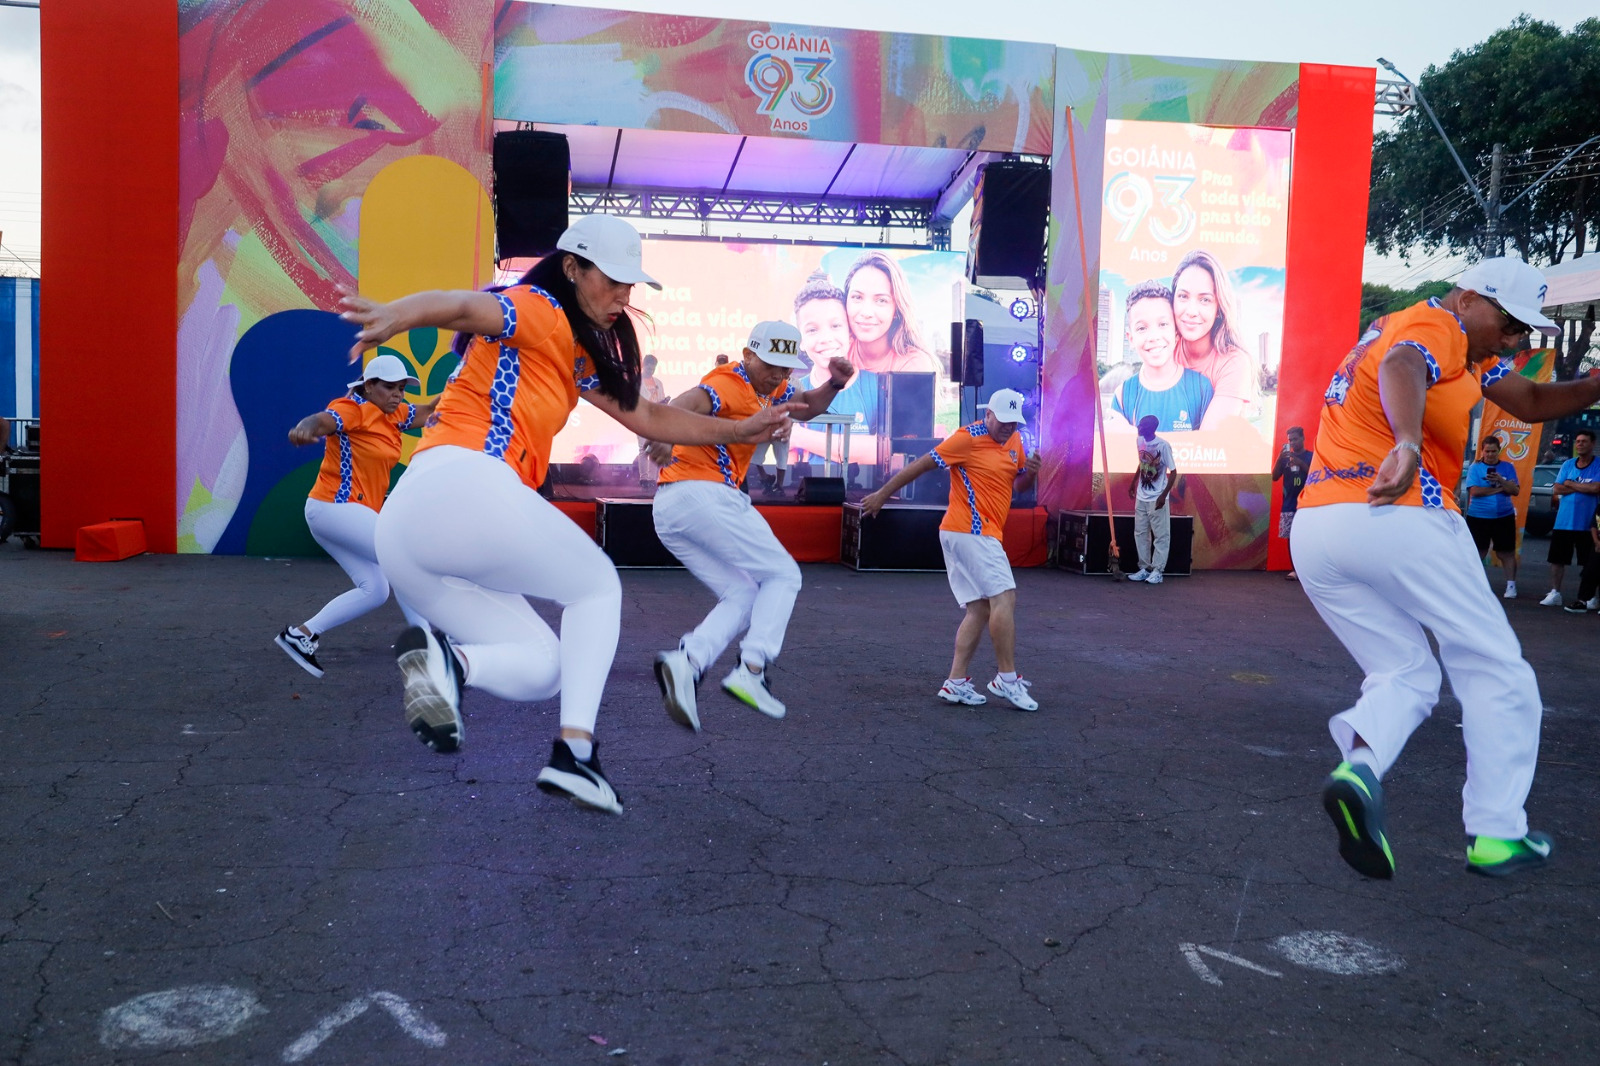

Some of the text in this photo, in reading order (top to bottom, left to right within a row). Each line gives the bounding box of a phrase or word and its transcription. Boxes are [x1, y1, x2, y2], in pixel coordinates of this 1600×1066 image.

[751, 33, 831, 54] GOIÂNIA
[749, 53, 834, 116] 93
[773, 118, 808, 131] Anos
[1107, 144, 1196, 170] GOIÂNIA
[1201, 169, 1233, 187] Pra
[1104, 171, 1197, 246] 93
[1201, 189, 1281, 211] toda vida,
[1200, 211, 1271, 227] pra todo
[1199, 227, 1260, 245] mundo.
[1129, 246, 1168, 262] Anos
[645, 334, 690, 352] pra
[1494, 418, 1532, 429] GOIÂNIA
